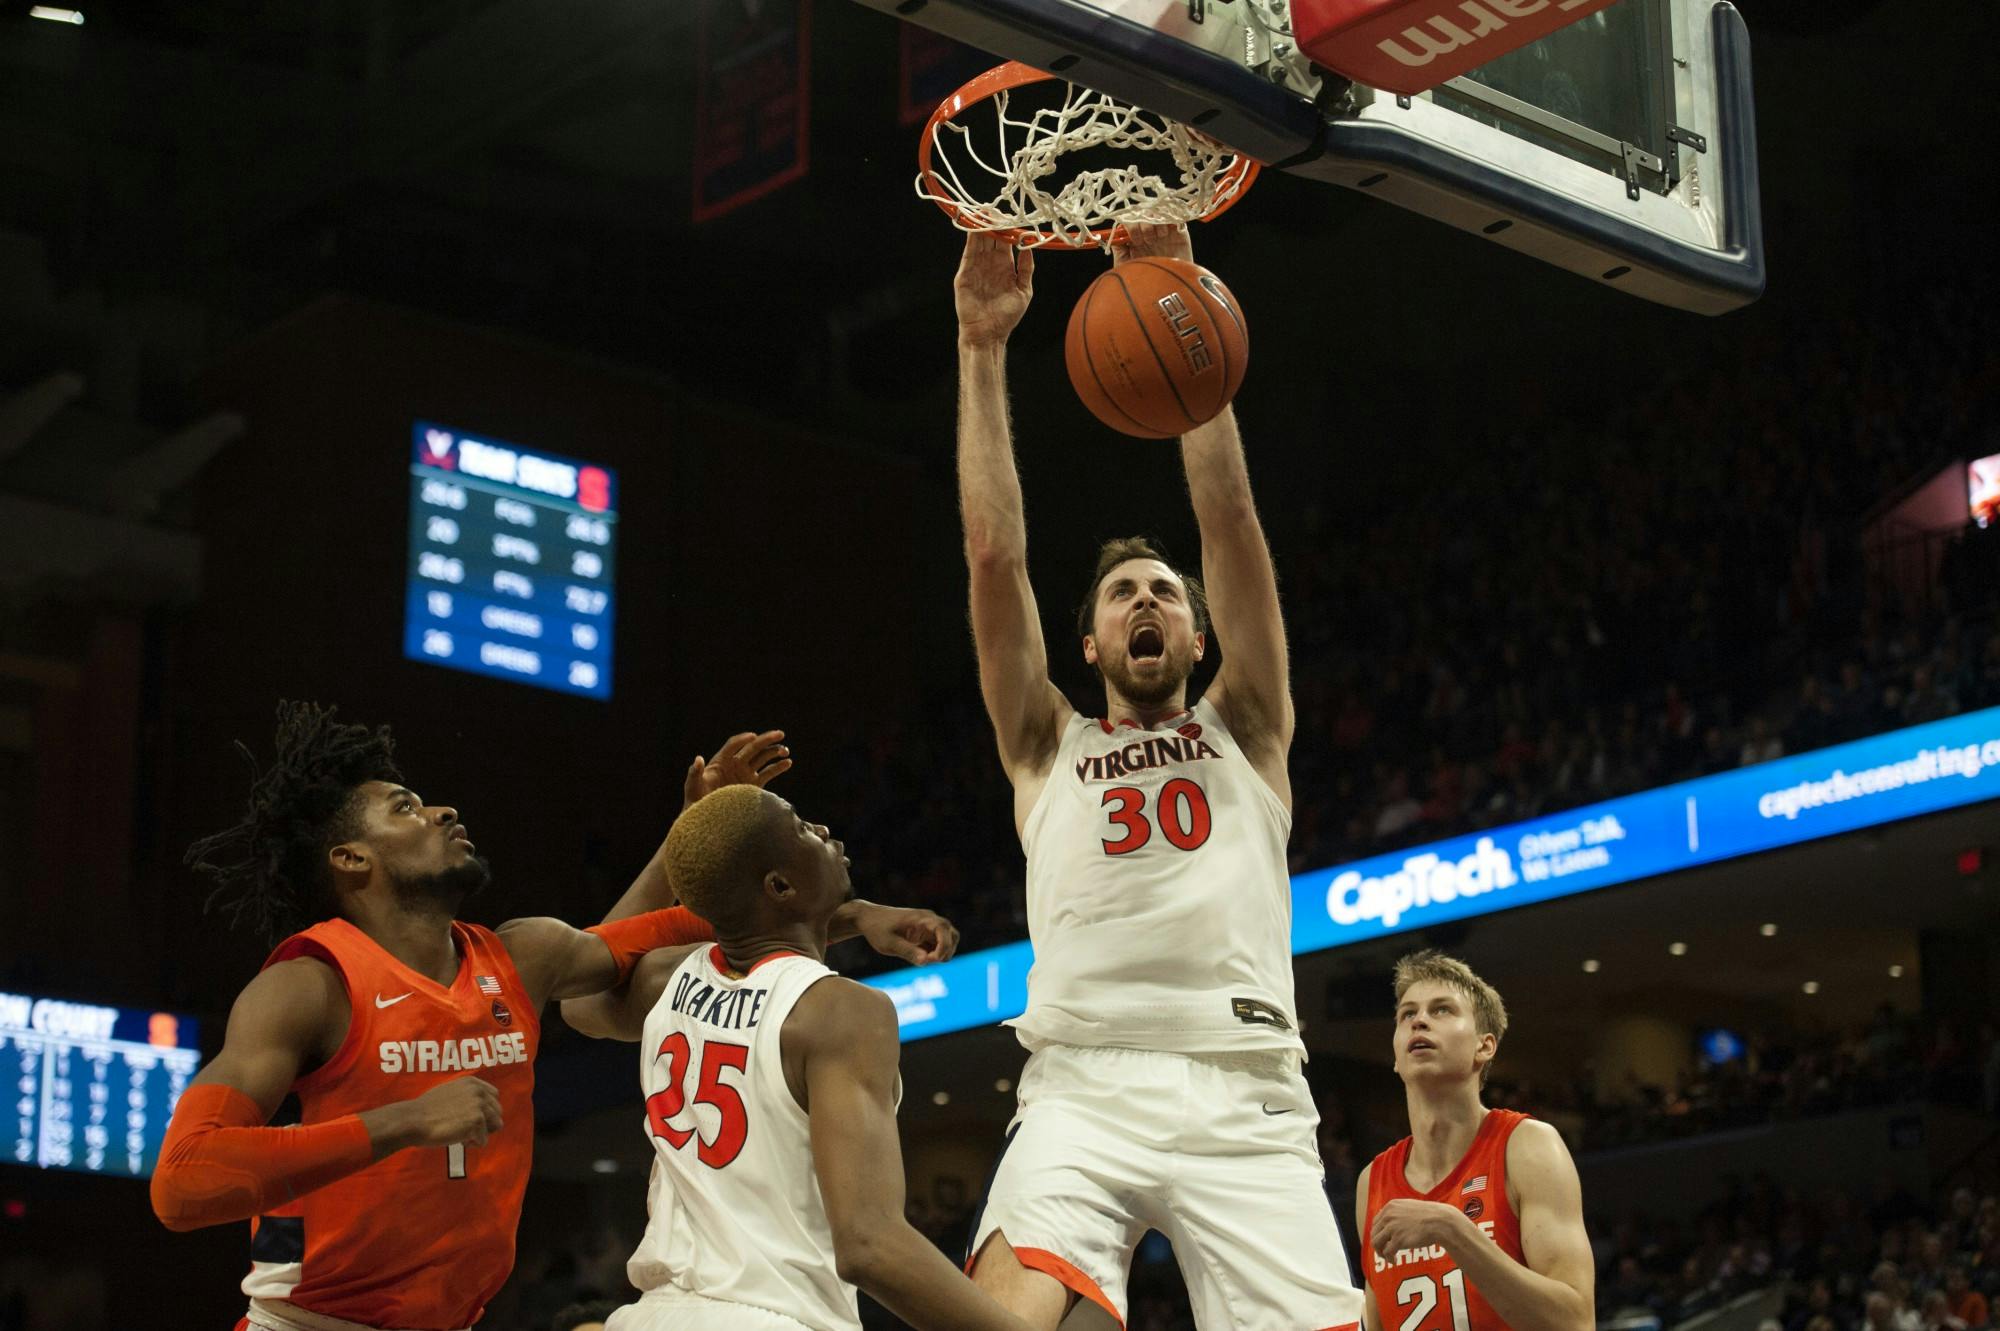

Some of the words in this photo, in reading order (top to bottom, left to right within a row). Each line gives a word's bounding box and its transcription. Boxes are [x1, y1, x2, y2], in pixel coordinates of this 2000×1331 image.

[1376, 0, 1590, 67] arm
[1158, 292, 1213, 377] ELITE
[1076, 736, 1224, 784] VIRGINIA
[1101, 778, 1212, 856] 30
[671, 971, 768, 1030] DIAKITE
[379, 1032, 529, 1074] SYRACUSE
[646, 1031, 749, 1170] 25
[1396, 1267, 1472, 1331] 21
